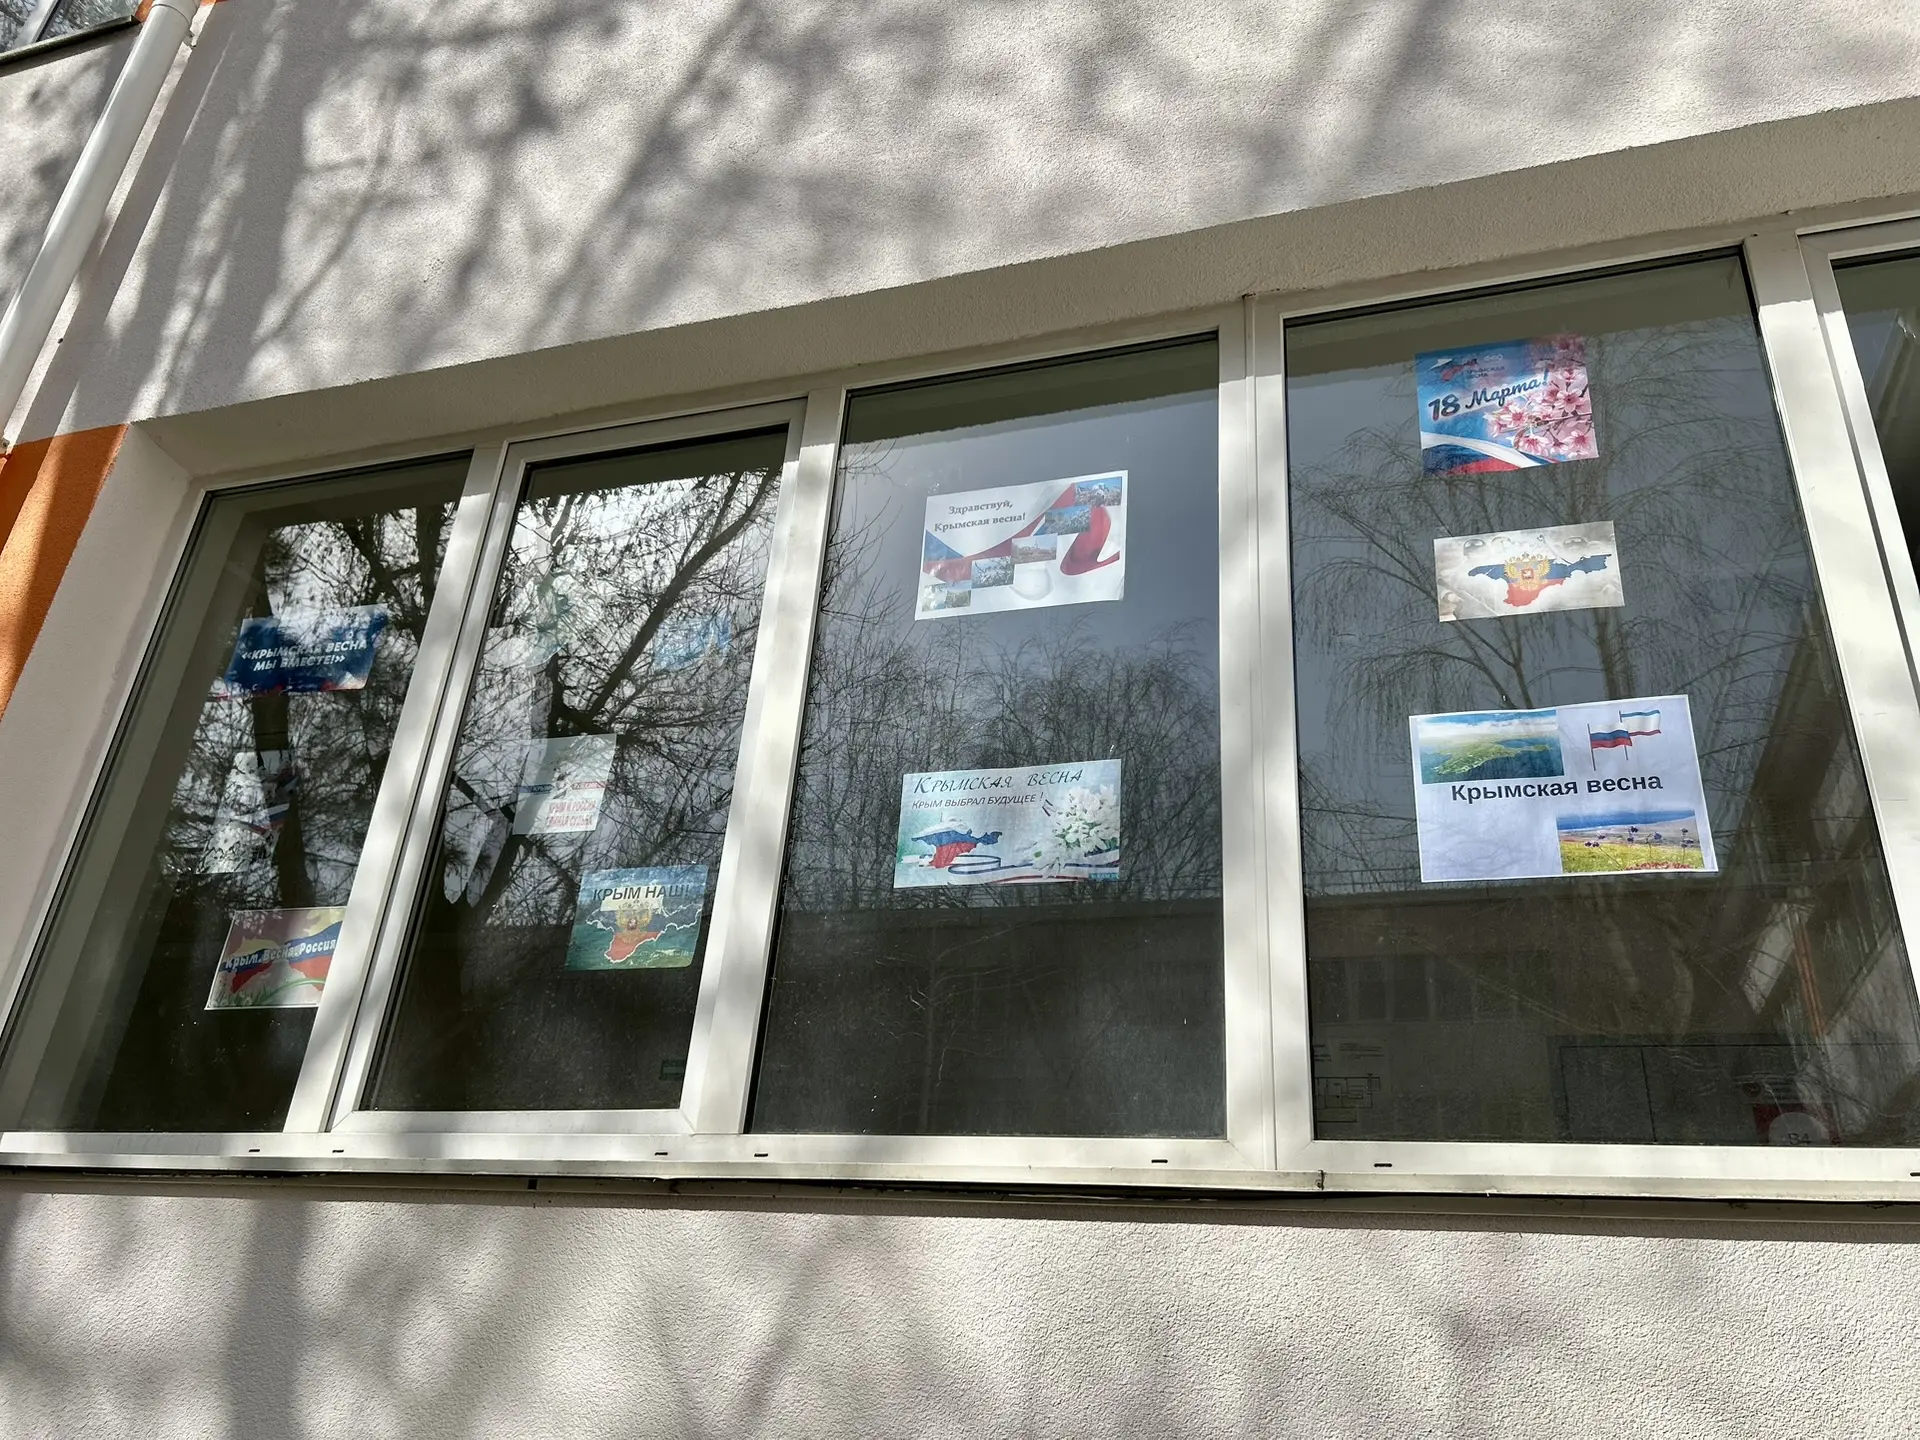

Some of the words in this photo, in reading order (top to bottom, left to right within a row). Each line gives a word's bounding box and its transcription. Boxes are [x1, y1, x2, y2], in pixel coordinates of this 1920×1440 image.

[1428, 394, 1461, 421] 18
[1465, 368, 1549, 408] Марта!
[948, 500, 1013, 515] Здравствуй,
[934, 518, 990, 533] Крымская
[992, 513, 1026, 524] весна!
[325, 640, 367, 653] ВЕСНА
[253, 660, 277, 672] МЫ
[279, 654, 346, 669] ВМЕСТЕ!»
[913, 775, 1015, 794] КРЫМСКАЯ
[1027, 769, 1084, 788] ВЕСНА
[1451, 779, 1578, 804] Крымская
[1586, 774, 1664, 795] весна
[911, 799, 944, 810] КРЫМ
[944, 797, 986, 808] ВЫБРАЛ
[593, 886, 641, 901] КРЫМ
[645, 884, 690, 900] НАШ!
[299, 939, 337, 956] Россия
